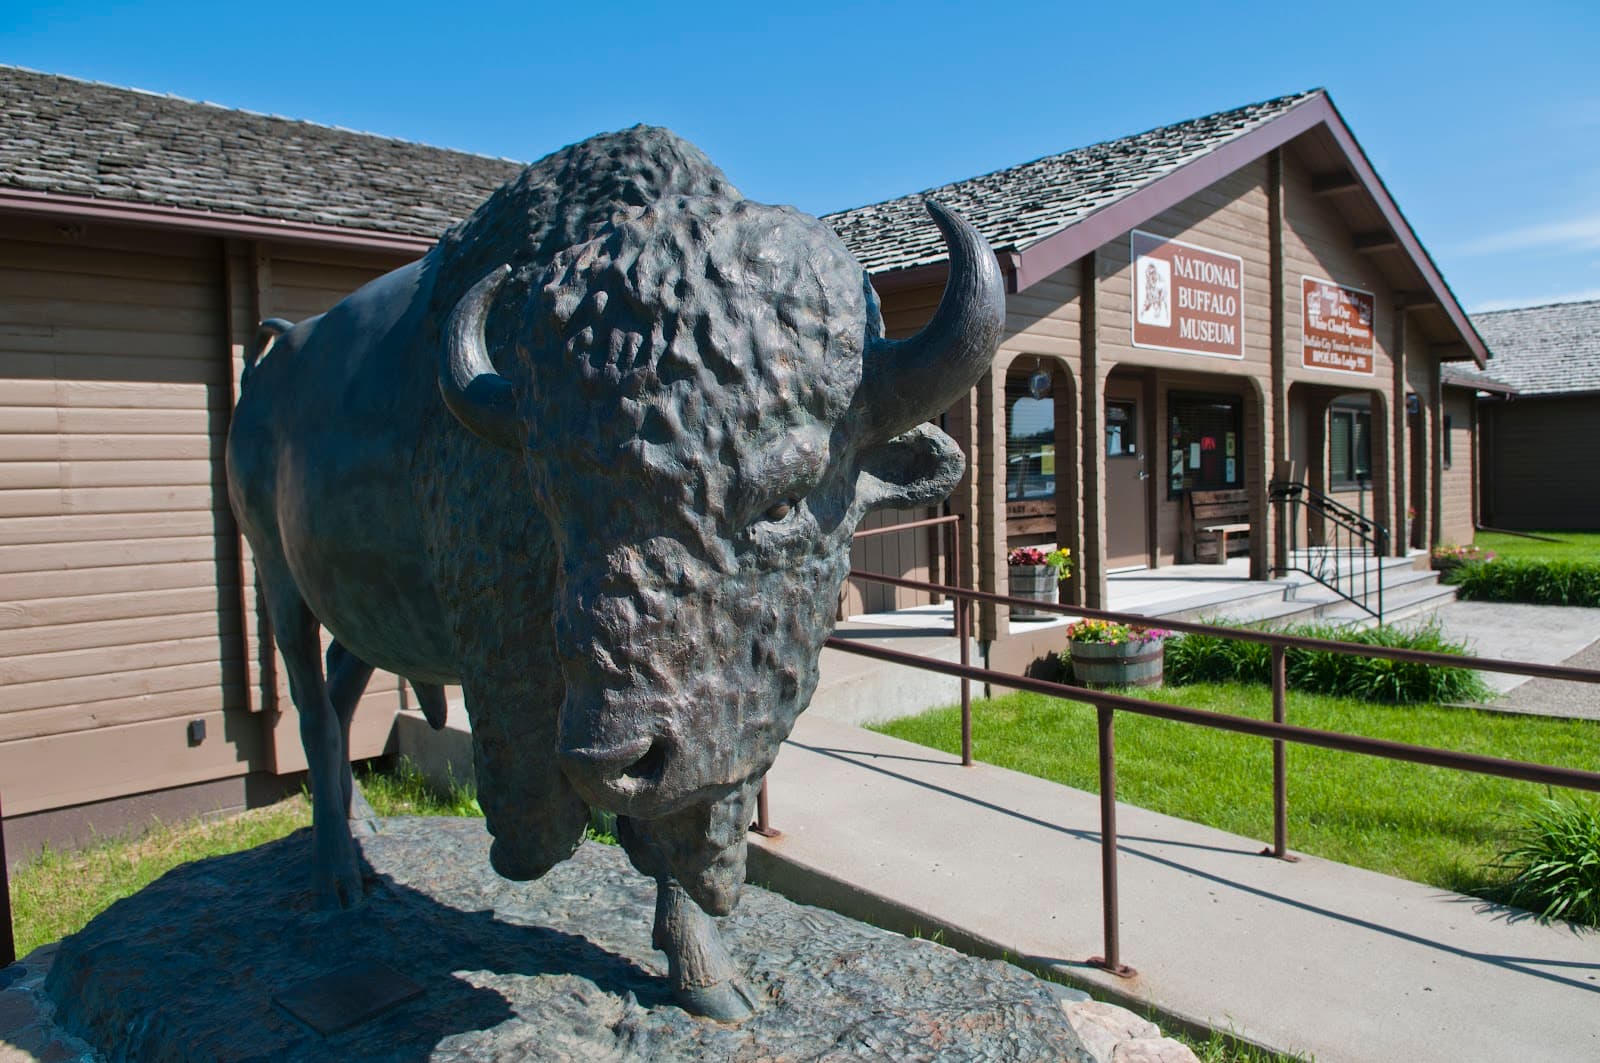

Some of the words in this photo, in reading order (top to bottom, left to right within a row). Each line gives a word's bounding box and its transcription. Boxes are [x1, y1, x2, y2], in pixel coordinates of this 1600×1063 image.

[1173, 254, 1239, 289] NATIONAL
[1178, 286, 1236, 317] BUFFALO
[1339, 305, 1351, 319] Our
[1179, 317, 1235, 345] MUSEUM
[1309, 314, 1327, 330] White
[1327, 318, 1345, 334] Cloud
[1345, 321, 1370, 338] Sponsors
